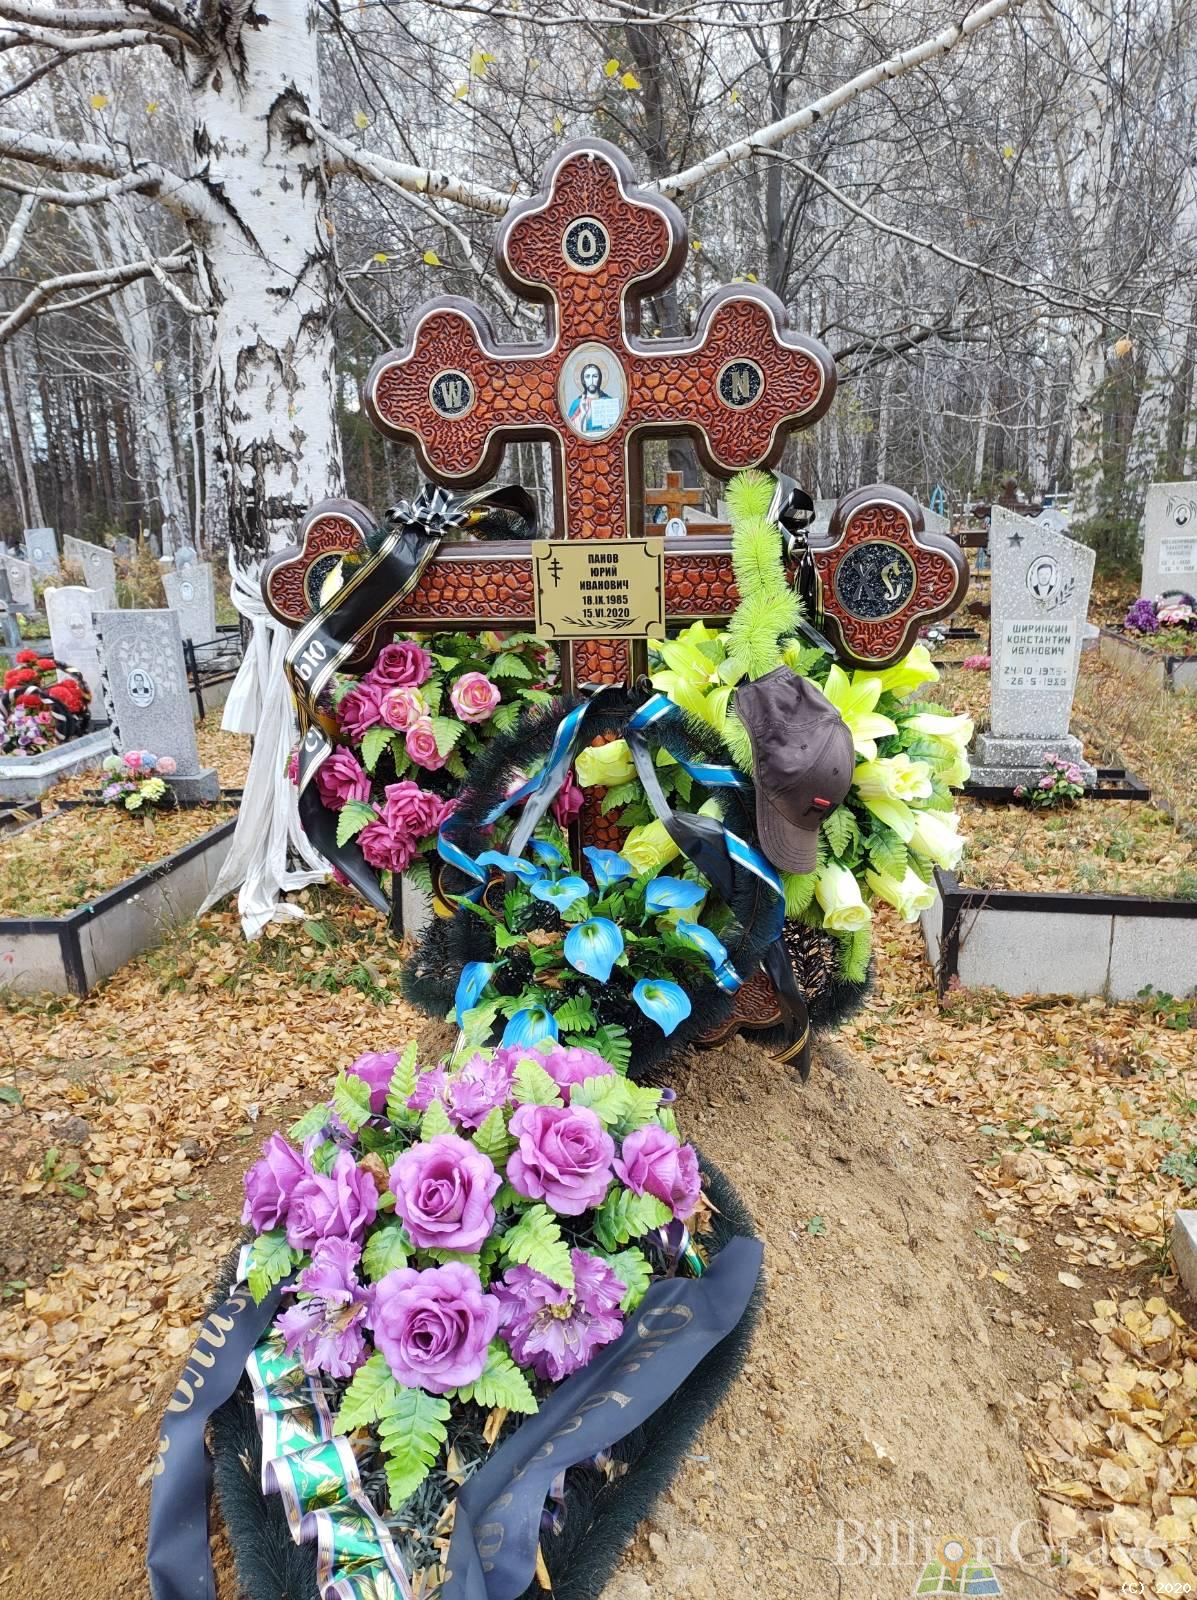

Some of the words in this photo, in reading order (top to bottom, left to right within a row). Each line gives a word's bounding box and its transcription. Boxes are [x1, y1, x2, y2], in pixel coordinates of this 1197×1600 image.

[587, 553, 619, 565] ПАНОВ
[590, 564, 618, 578] ЮРИЙ
[579, 579, 629, 591] ИВАНОВИЧ
[582, 594, 629, 606] 18.IX.1985
[582, 607, 630, 619] 15.VI.2020
[1012, 623, 1068, 634] ШИРИНКИН
[1007, 635, 1071, 645] КОНСТАНТИН
[1011, 646, 1065, 656] ИВАНОВИЧ
